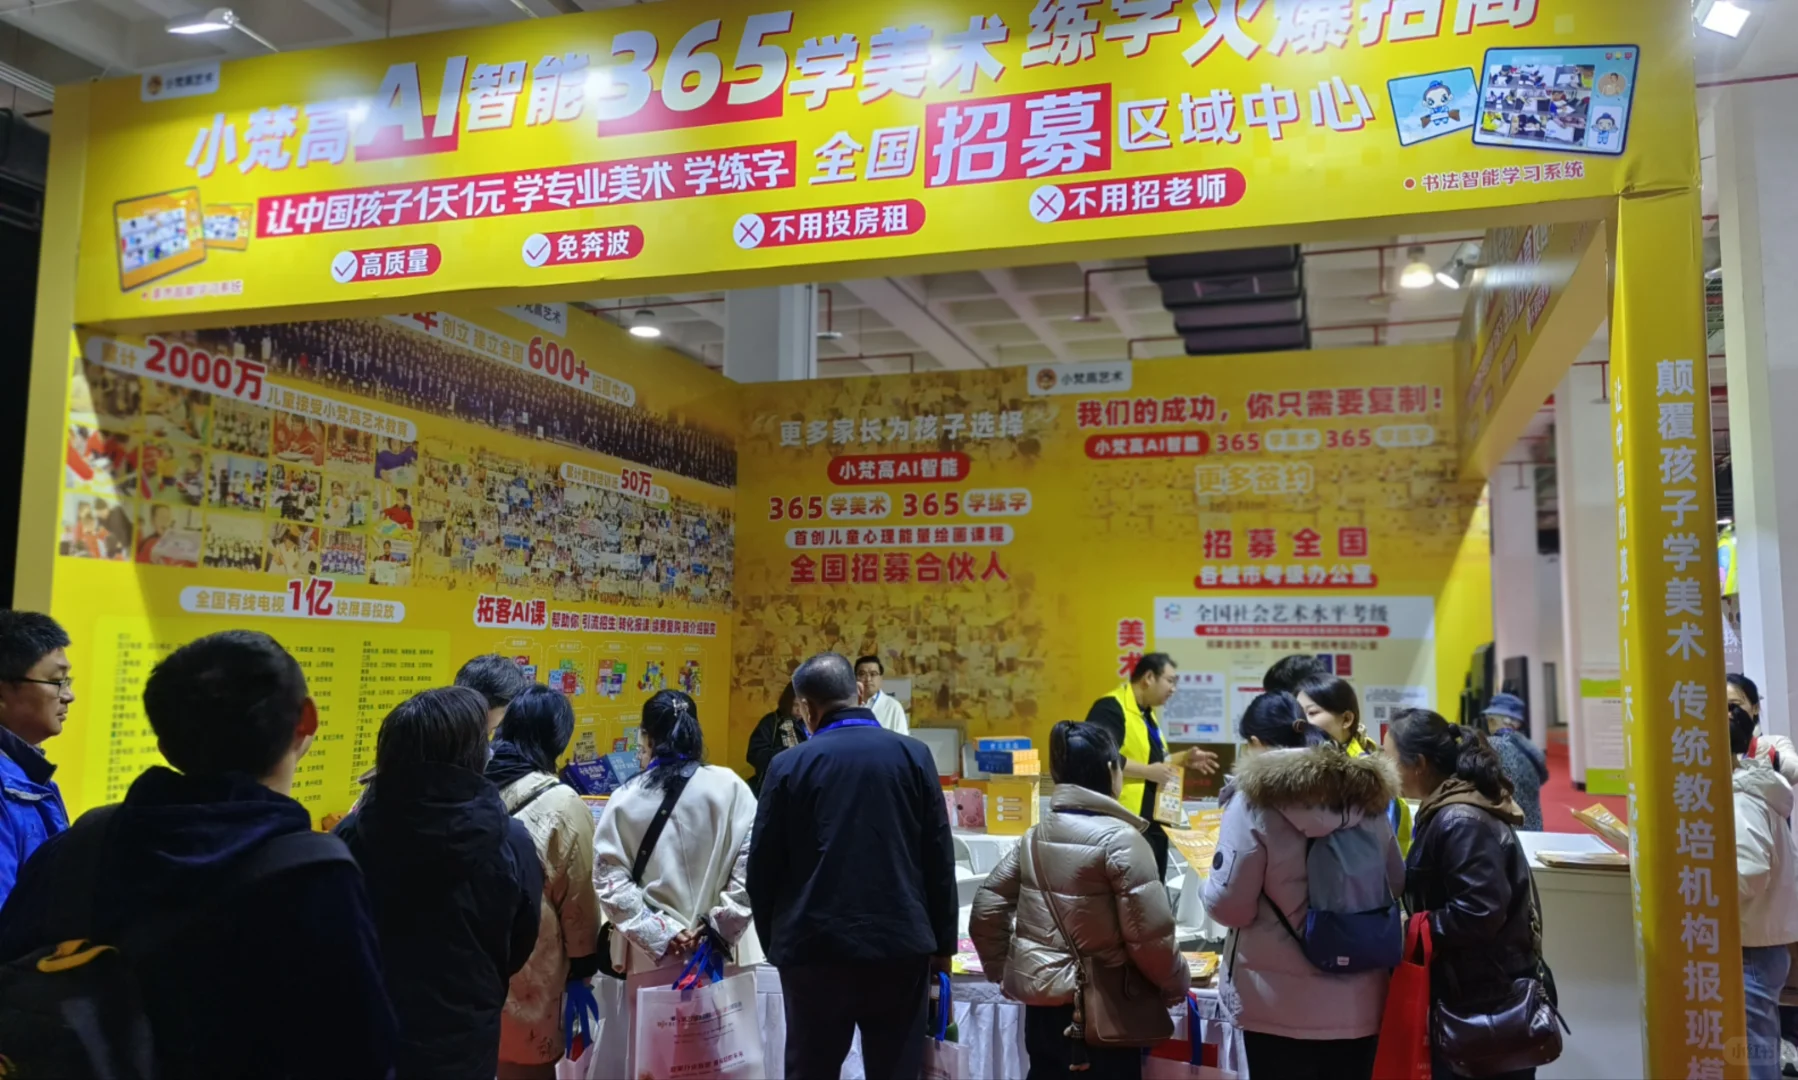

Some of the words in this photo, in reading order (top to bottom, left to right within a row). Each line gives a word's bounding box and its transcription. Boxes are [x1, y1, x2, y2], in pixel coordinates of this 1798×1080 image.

[512, 161, 675, 212] 学专业美术
[684, 148, 789, 196] 学练字
[1421, 160, 1584, 192] 书法智能学习系统
[1069, 173, 1226, 215] 不用招老师
[770, 204, 908, 242] 不用投房租
[556, 230, 630, 261] 免奔波
[361, 249, 430, 277] 高质量
[839, 457, 958, 480] 小梵高AI智能
[1656, 359, 1707, 661] 颠覆孩子学美术
[790, 550, 1010, 585] 全国招募合伙人
[477, 594, 547, 626] 拓客AI课
[1196, 603, 1389, 623] 全国社会艺术水平考级
